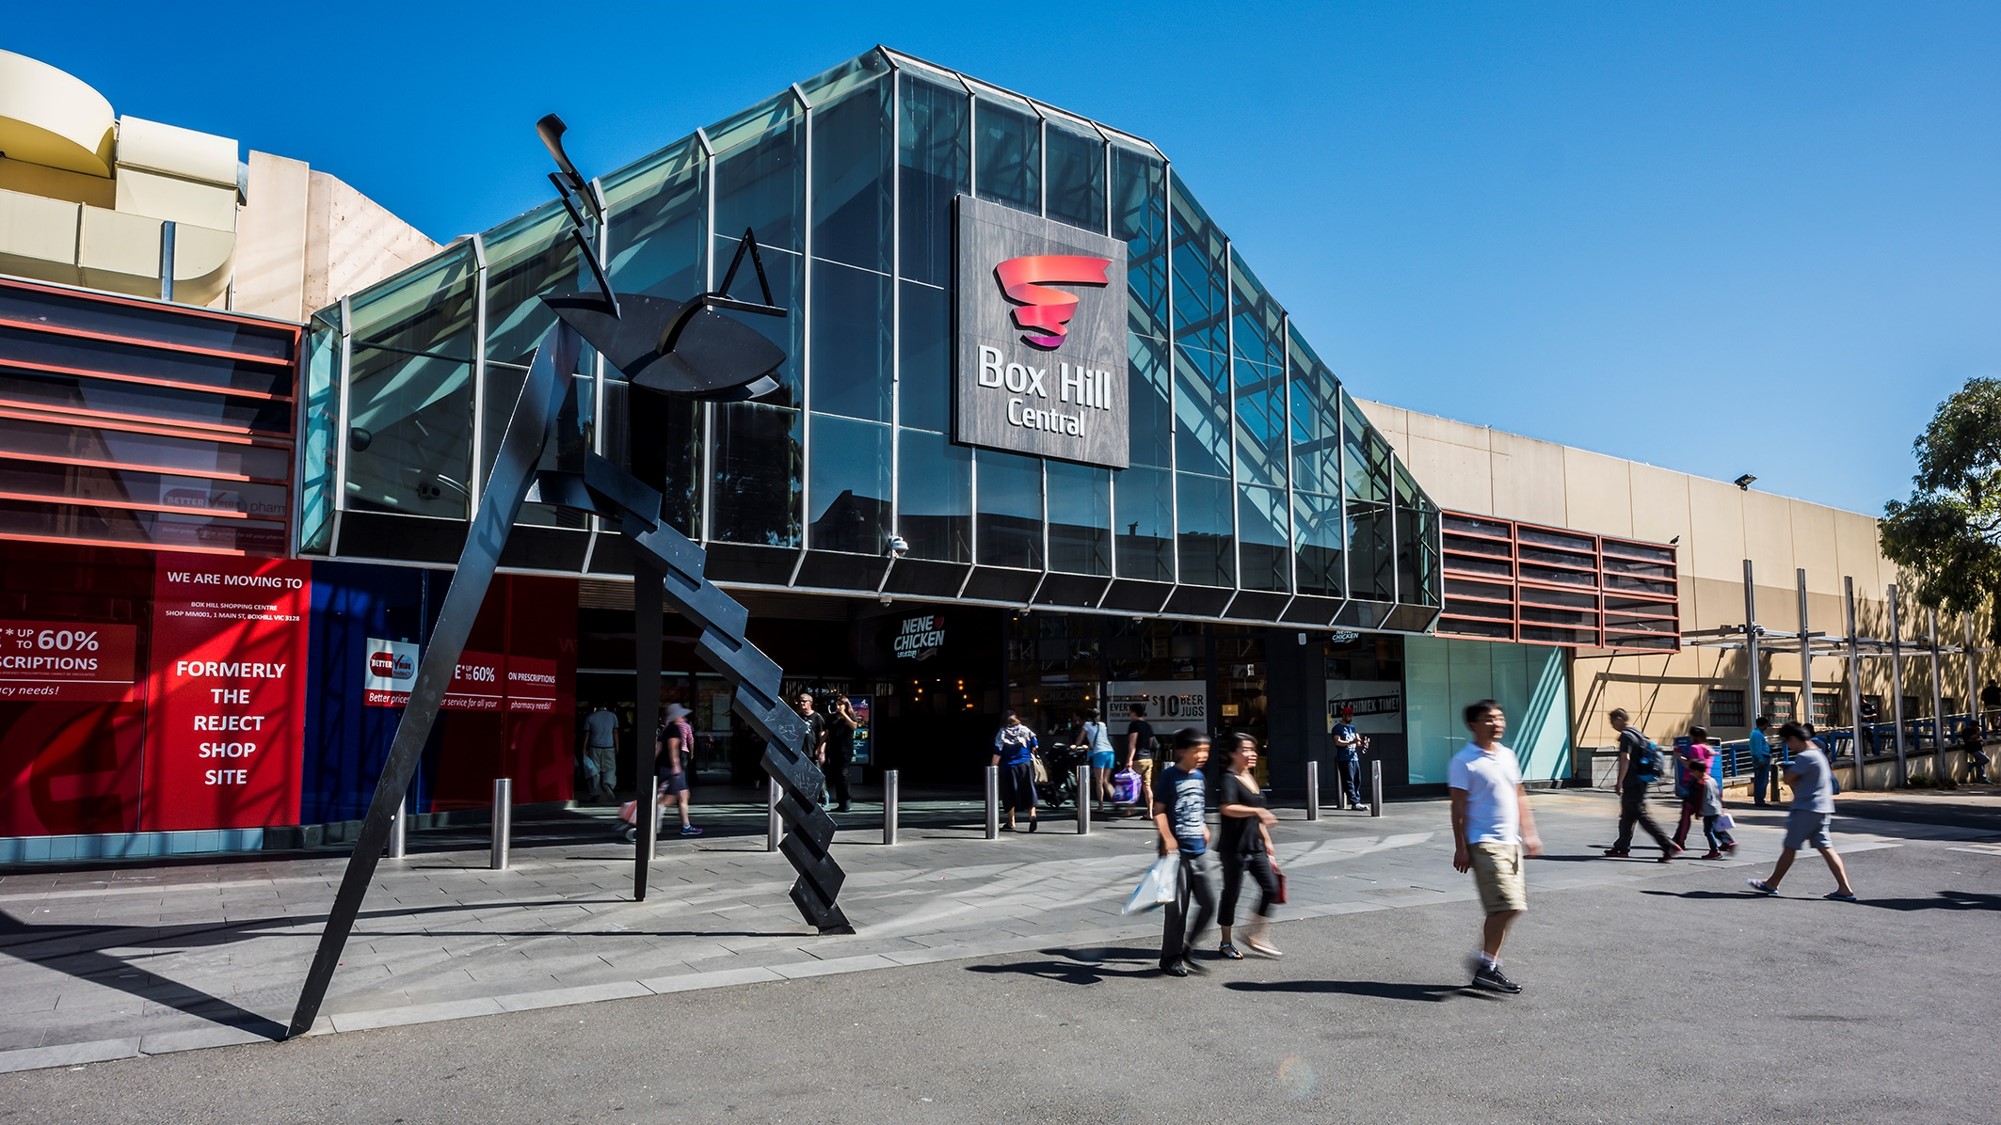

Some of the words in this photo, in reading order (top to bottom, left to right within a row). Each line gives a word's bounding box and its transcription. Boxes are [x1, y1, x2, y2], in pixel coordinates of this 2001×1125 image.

[978, 345, 1047, 397] Box
[1060, 362, 1110, 410] Hill
[1007, 397, 1085, 437] Central
[167, 571, 191, 583] WE
[193, 573, 221, 585] ARE
[224, 575, 282, 588] MOVING
[285, 578, 303, 589] TO
[901, 614, 934, 635] NENE
[17, 628, 34, 638] UP
[38, 629, 99, 651] 60%
[893, 630, 945, 651] CHICKEN
[16, 639, 33, 649] TO
[0, 656, 98, 670] CRIPTIONS
[176, 660, 287, 678] FORMERLY
[371, 658, 393, 669] BETTER
[472, 666, 496, 682] 60%
[508, 672, 517, 680] ON
[517, 673, 556, 684] PRESCRIPTIONS
[0, 686, 16, 697] cy
[18, 685, 60, 695] needs!
[210, 688, 251, 704] THE
[368, 692, 391, 703] Better
[447, 699, 467, 707] service
[467, 698, 476, 709] for
[477, 699, 485, 707] all
[485, 700, 498, 710] your
[511, 700, 535, 711] pharmacy
[535, 702, 552, 710] needs!
[1180, 694, 1205, 706] BEER
[1378, 697, 1399, 710] TIME!
[1180, 706, 1205, 717] JUGS
[193, 715, 265, 731] REJECT
[198, 742, 257, 758] SHOP
[204, 769, 248, 785] SITE
